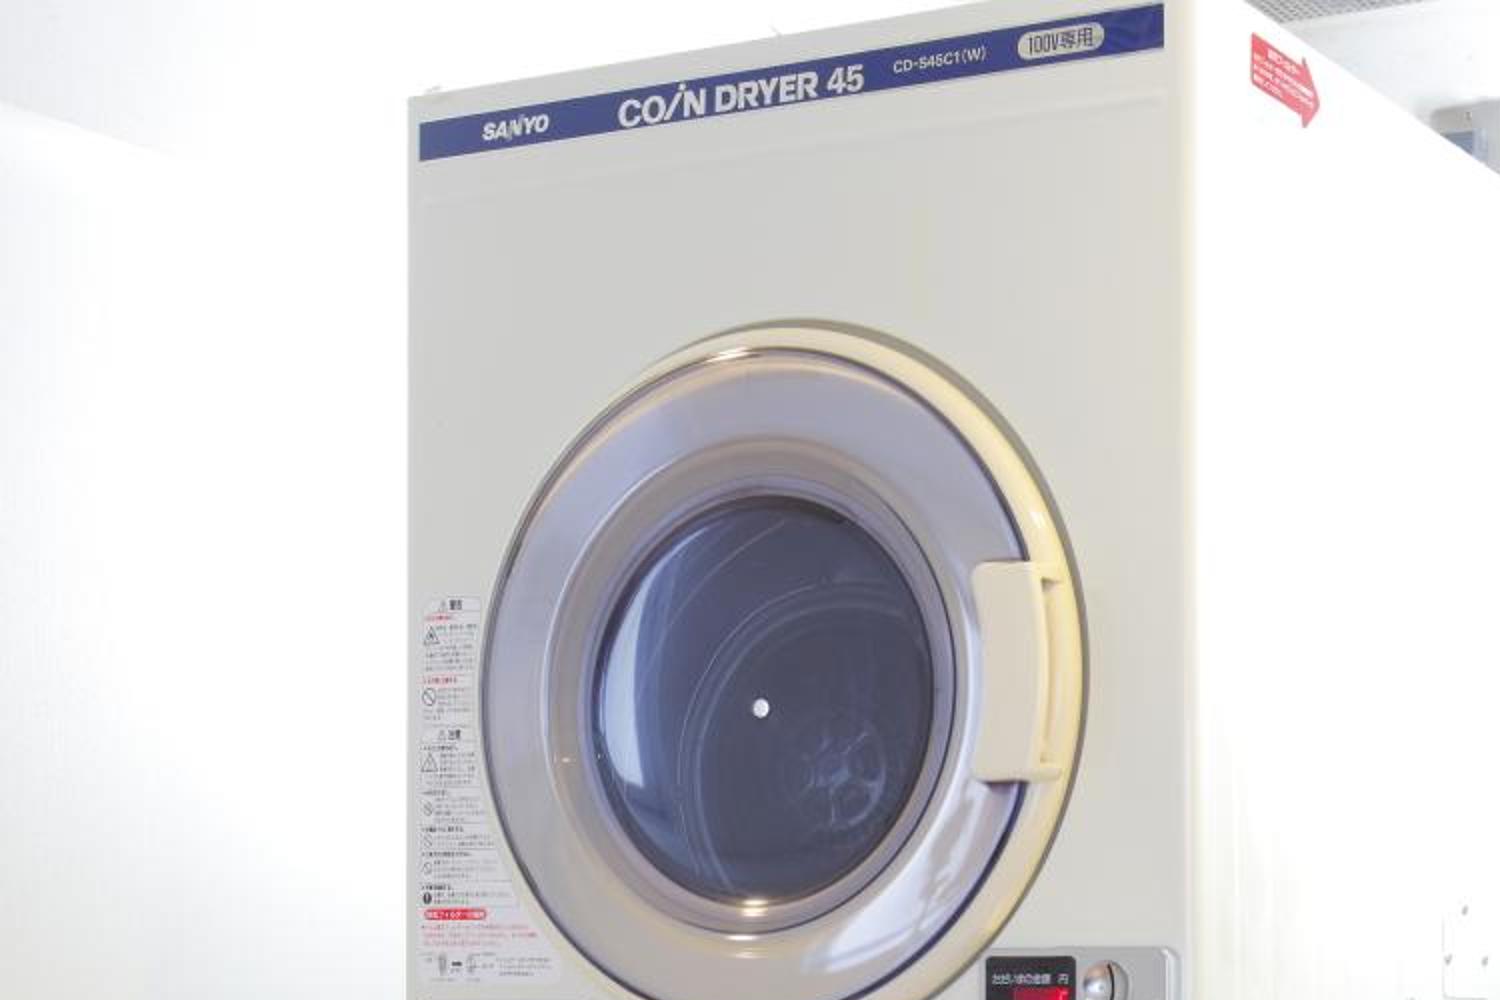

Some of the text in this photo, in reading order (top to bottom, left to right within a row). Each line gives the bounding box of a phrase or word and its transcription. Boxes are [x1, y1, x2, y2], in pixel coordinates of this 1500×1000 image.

[715, 71, 818, 112] DRYER
[827, 63, 865, 93] 45
[482, 113, 550, 141] SANYO
